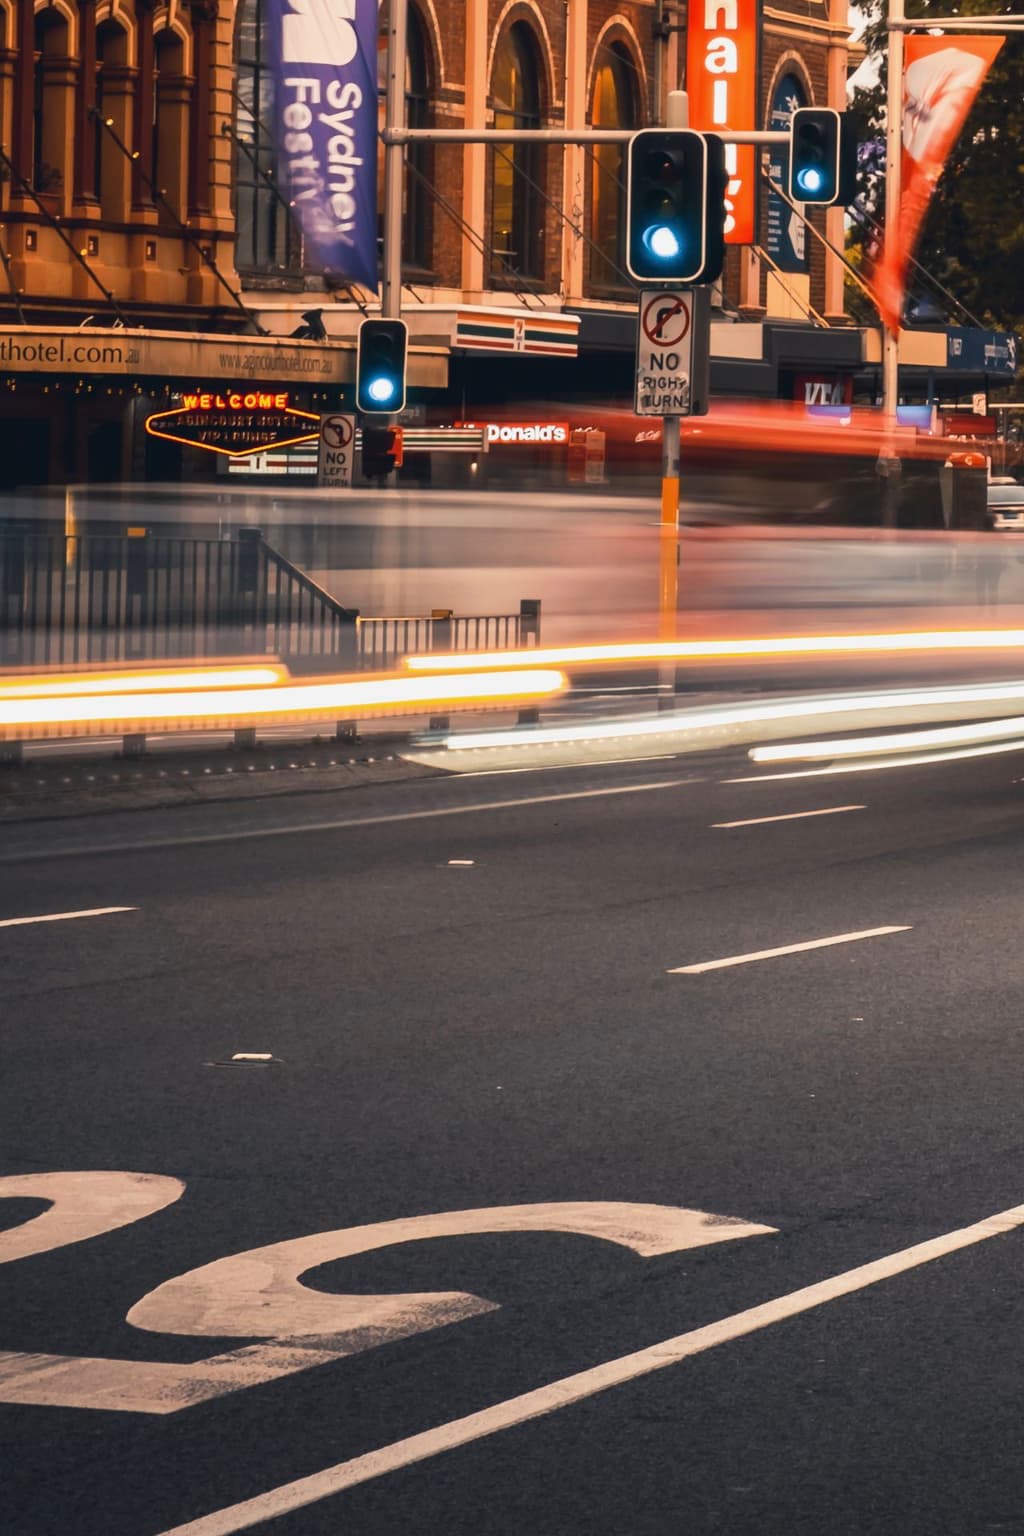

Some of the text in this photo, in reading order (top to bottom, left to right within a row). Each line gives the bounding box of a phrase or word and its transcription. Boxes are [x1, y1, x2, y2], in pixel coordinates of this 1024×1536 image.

[650, 353, 680, 370] NO
[642, 377, 687, 390] RIGHT
[183, 394, 288, 409] WELCOME
[642, 394, 683, 407] TURN
[466, 423, 567, 442] Donald's
[327, 452, 346, 465] NO
[323, 467, 348, 476] LEFT
